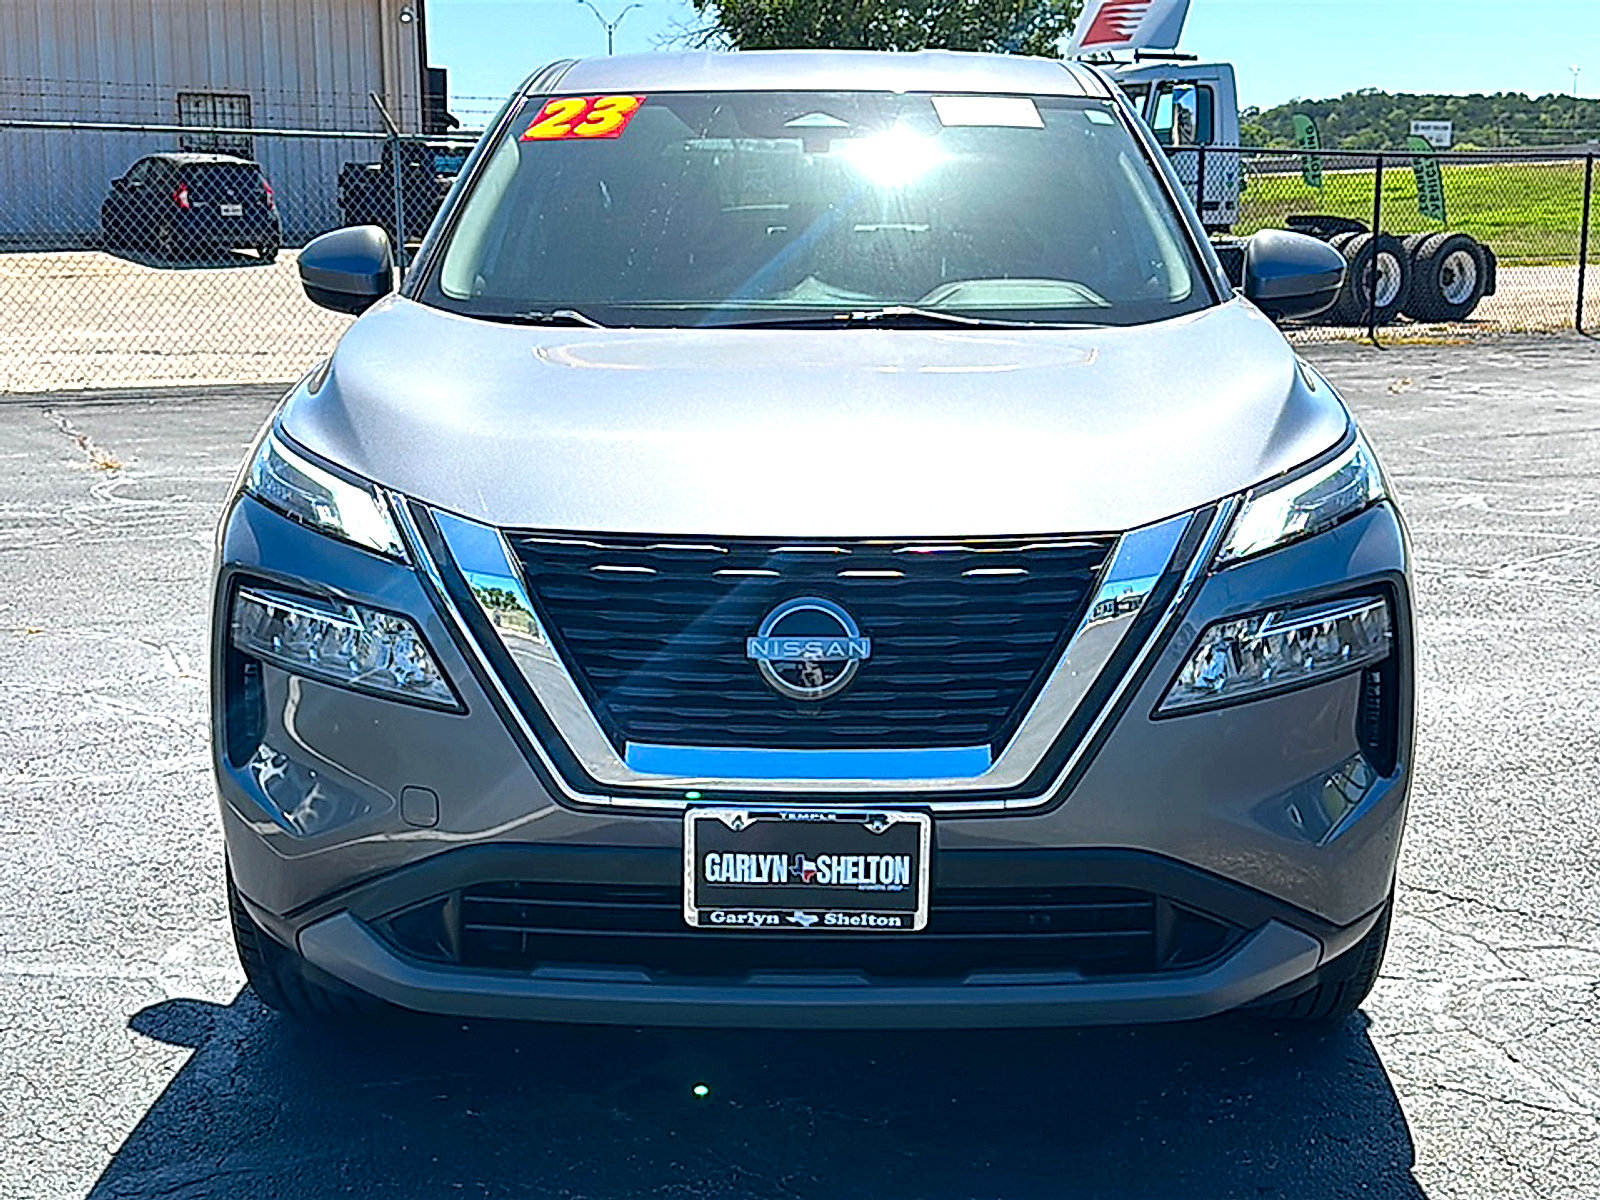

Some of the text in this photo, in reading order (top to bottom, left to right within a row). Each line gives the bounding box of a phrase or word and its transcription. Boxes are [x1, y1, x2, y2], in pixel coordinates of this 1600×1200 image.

[525, 96, 638, 138] 23
[750, 641, 867, 657] NISSAN
[705, 852, 910, 885] GARLYN SHELTON
[710, 911, 902, 928] Garlyn Shelton
